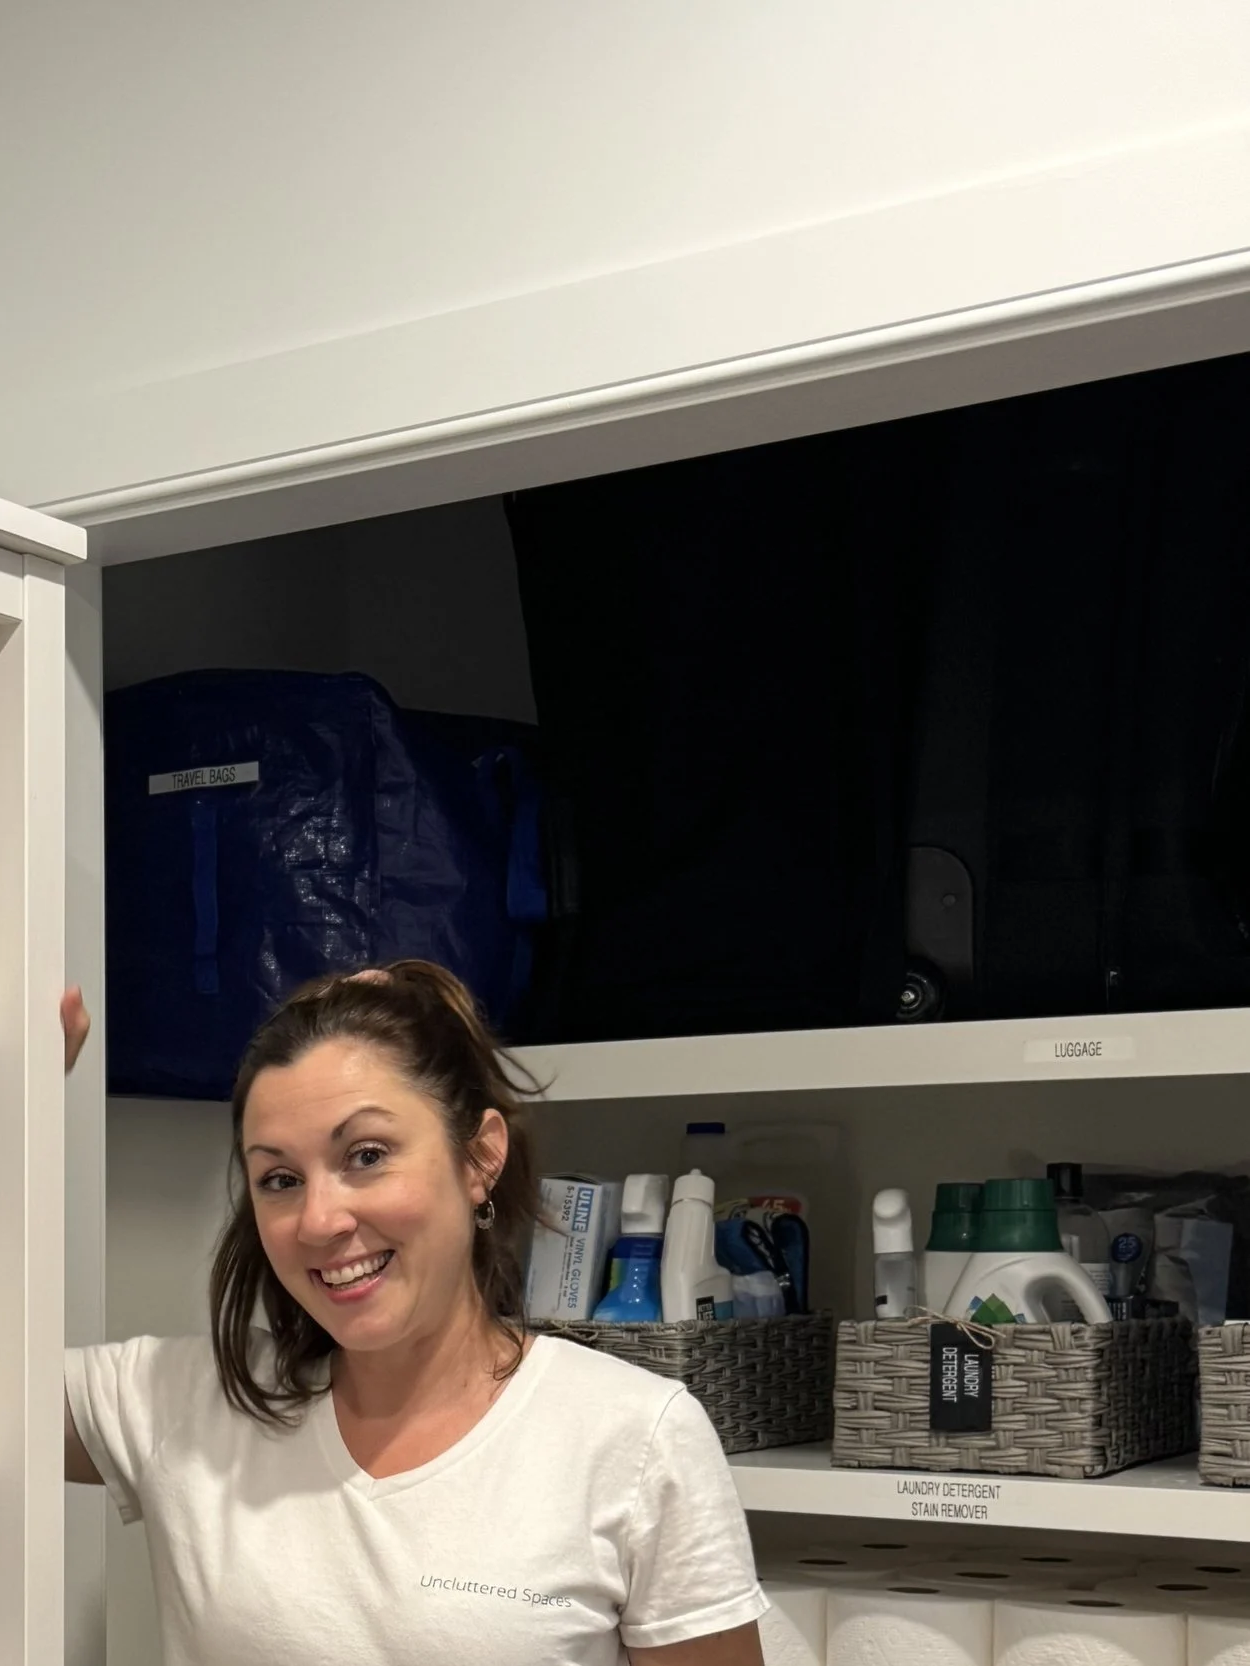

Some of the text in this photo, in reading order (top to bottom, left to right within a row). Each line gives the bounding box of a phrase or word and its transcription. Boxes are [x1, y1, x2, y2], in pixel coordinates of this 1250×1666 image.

[172, 766, 236, 789] TRAVEL BAGS
[1054, 1041, 1102, 1059] LUGGAGE
[567, 1189, 592, 1309] ULINE VINYL GLOVES
[942, 1347, 958, 1403] DETERGENT
[963, 1353, 979, 1398] LAUNDRY
[897, 1480, 1001, 1499] LAUNDRY DETERGENT
[911, 1501, 988, 1519] STAIN REMOVER
[420, 1574, 572, 1607] Uncluttered Spaces
